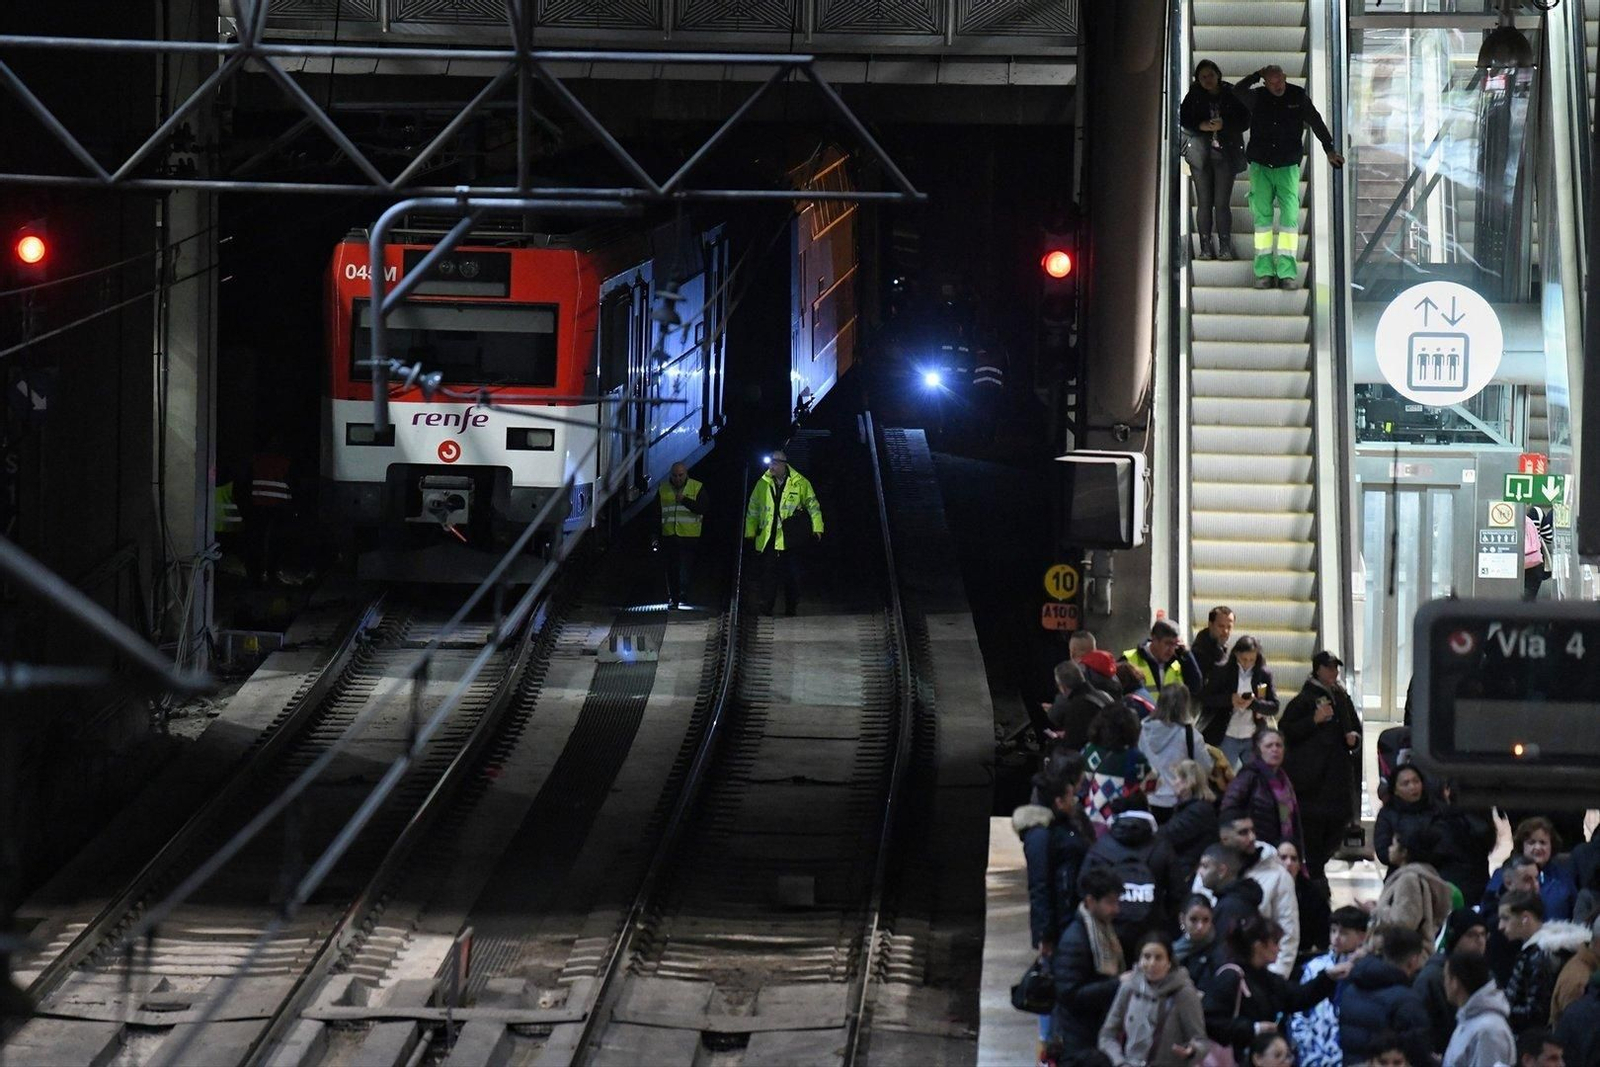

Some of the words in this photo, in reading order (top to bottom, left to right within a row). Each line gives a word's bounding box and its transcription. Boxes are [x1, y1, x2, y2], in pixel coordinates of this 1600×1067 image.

[412, 406, 489, 434] renfe
[1052, 571, 1075, 592] 10
[1044, 605, 1077, 619] A100
[1565, 632, 1586, 660] 4
